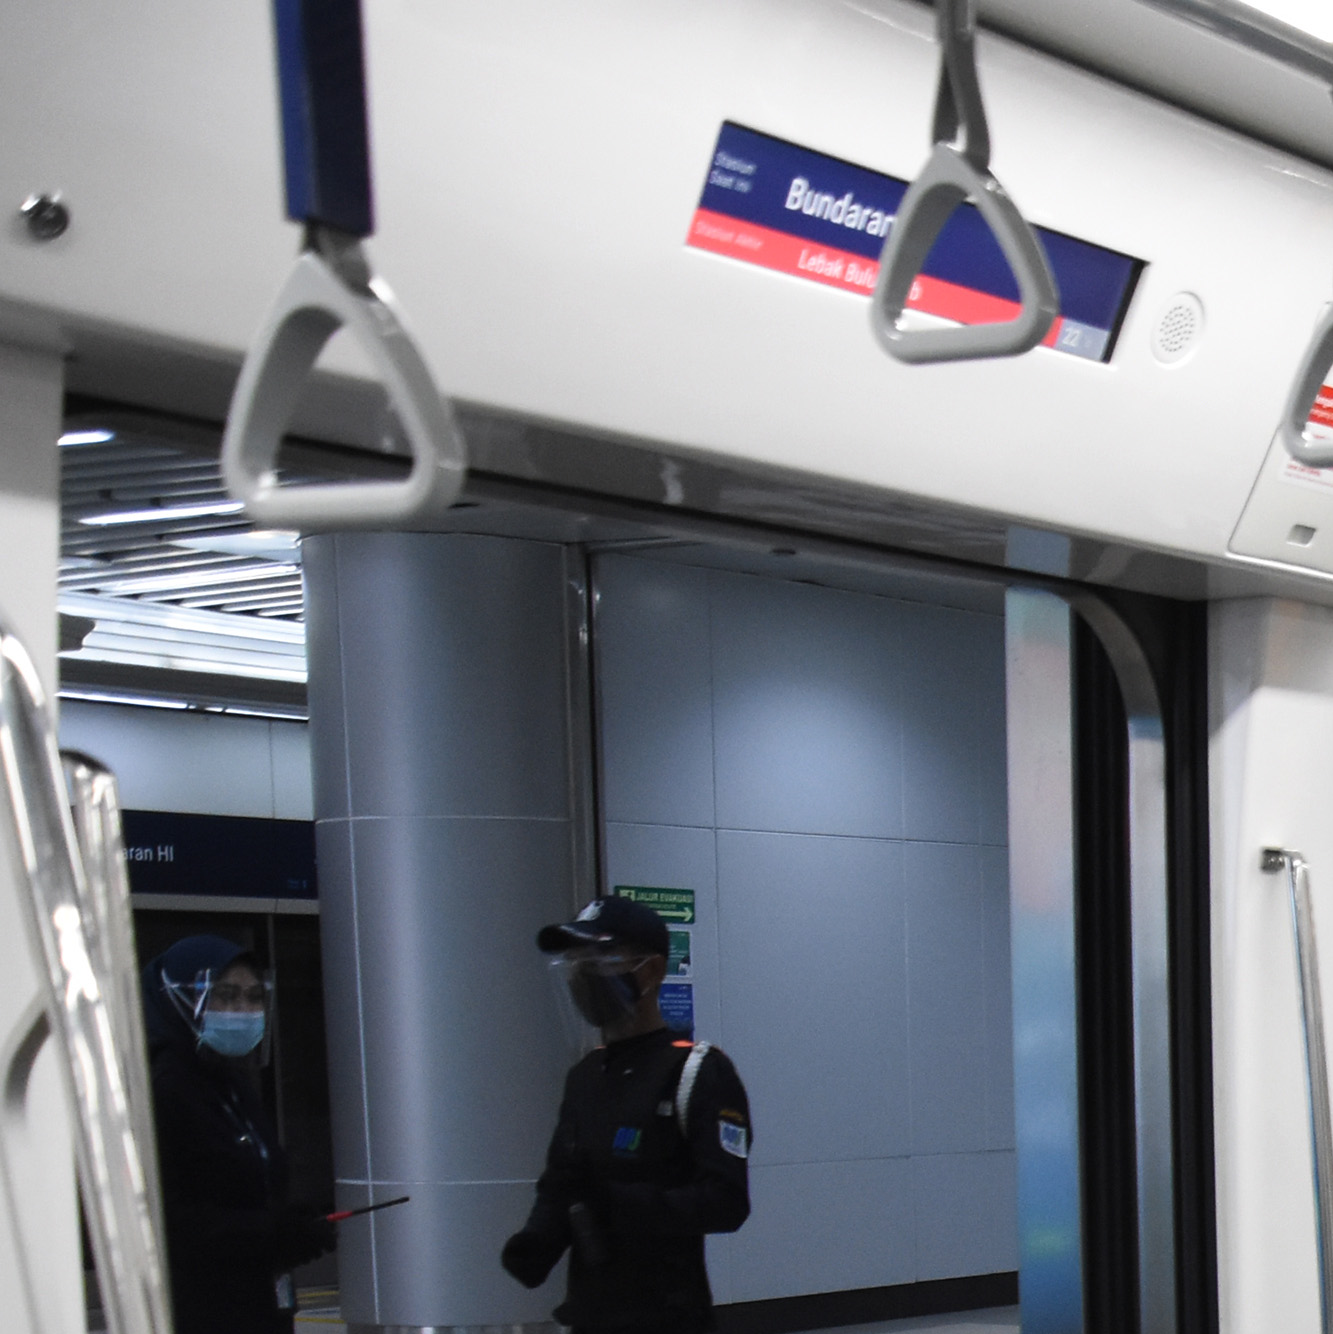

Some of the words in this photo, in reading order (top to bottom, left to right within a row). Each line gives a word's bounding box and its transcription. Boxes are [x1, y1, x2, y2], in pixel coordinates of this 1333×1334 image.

[797, 249, 844, 279] Lebak
[844, 262, 878, 289] Bulu
[157, 846, 174, 862] HI
